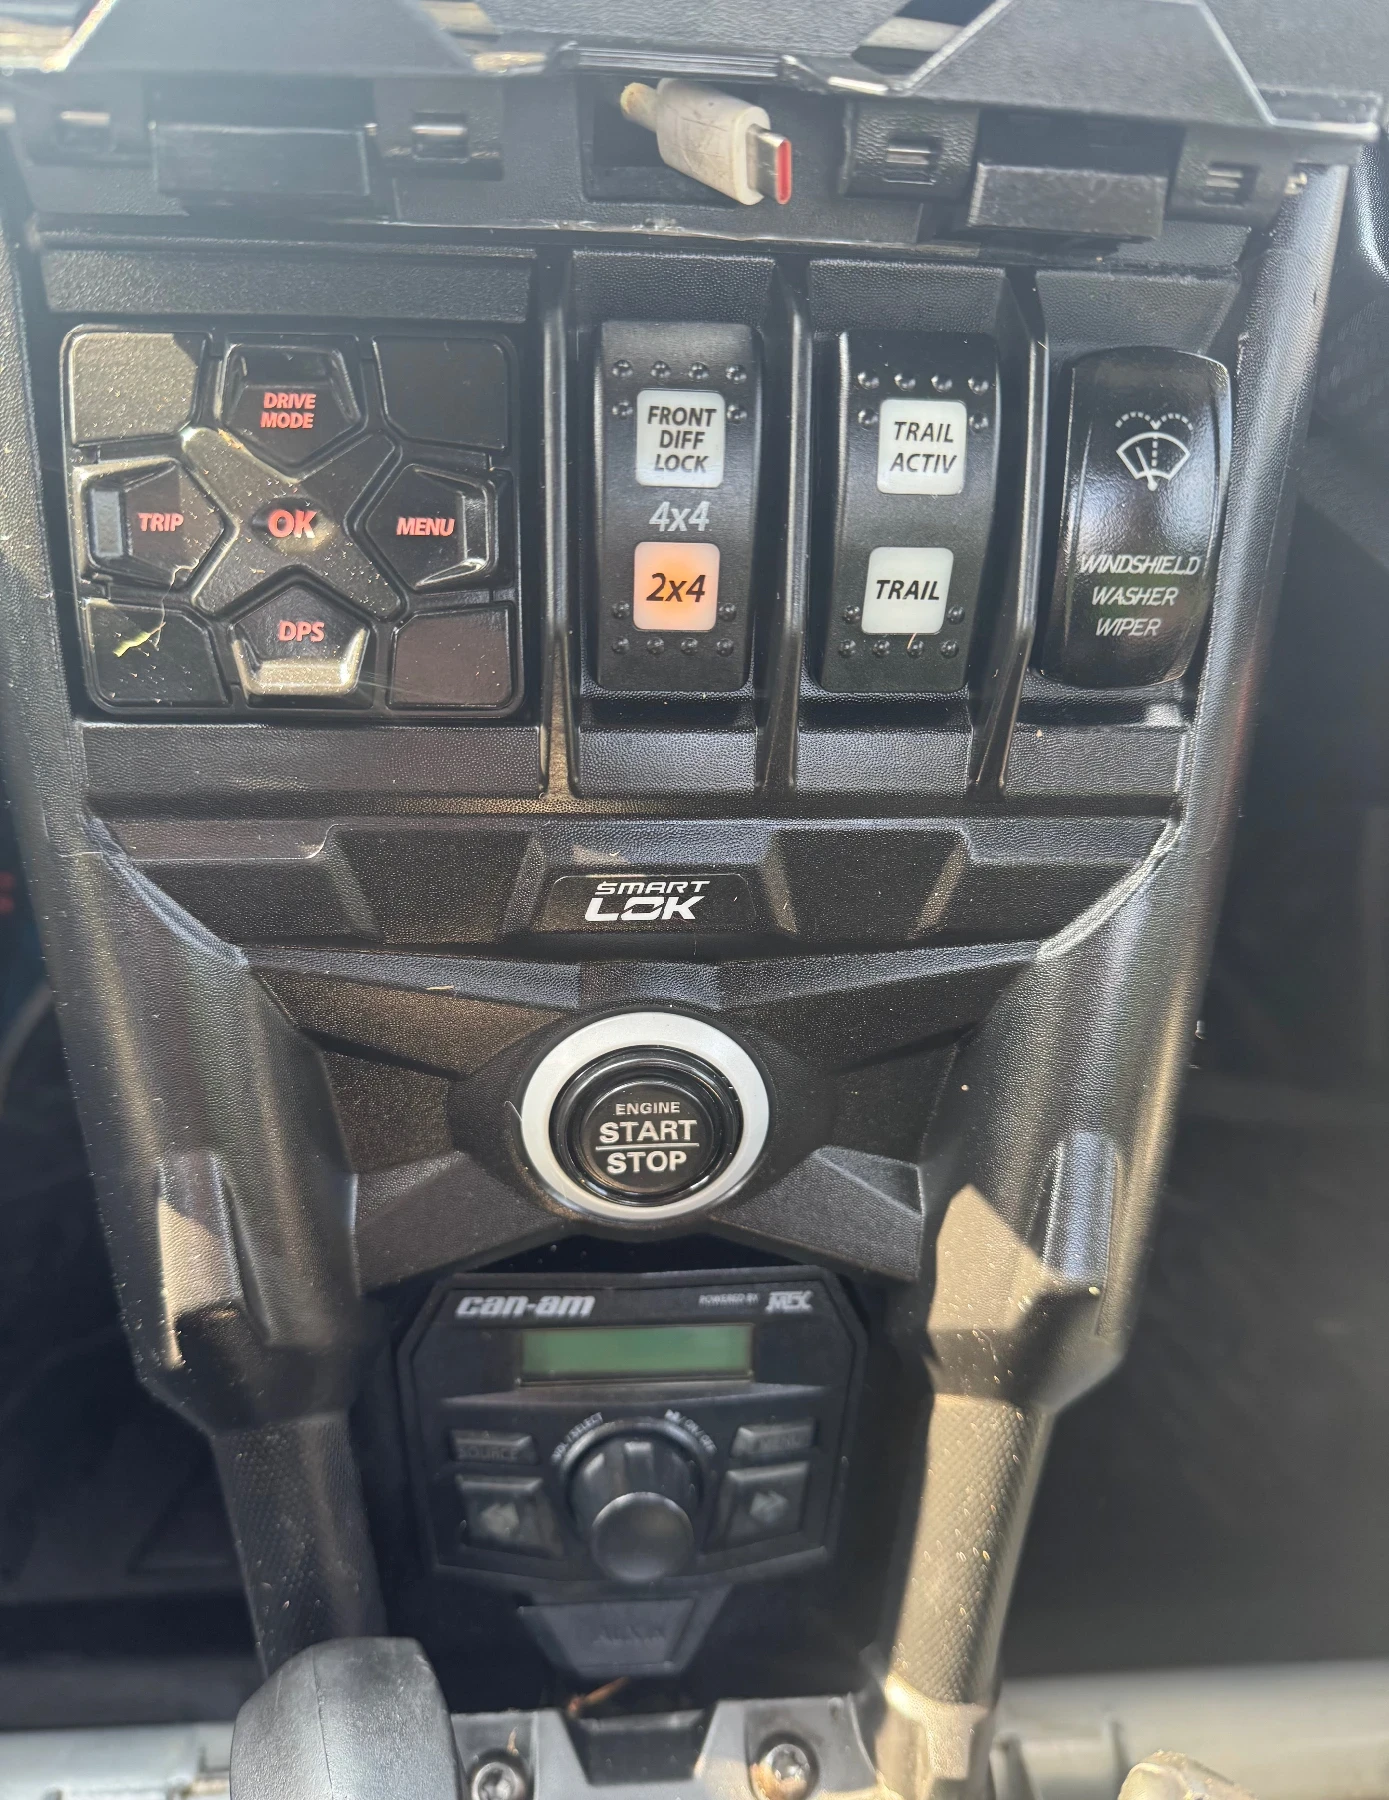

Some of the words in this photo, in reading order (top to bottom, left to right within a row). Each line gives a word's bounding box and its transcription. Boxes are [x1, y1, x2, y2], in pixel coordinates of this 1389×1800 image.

[262, 391, 317, 410] DRIVE
[260, 411, 314, 430] MODE
[647, 404, 717, 428] FRONT
[659, 430, 705, 450] DIFF
[893, 421, 954, 444] TRAIL
[654, 453, 709, 474] LOCK
[889, 452, 957, 475] ACTIV
[137, 512, 184, 532] TRIP
[267, 509, 317, 539] OK
[396, 517, 455, 537] MENU
[649, 501, 710, 532] 4x4
[1078, 554, 1201, 576] WINDSHIELD
[646, 572, 706, 603] 2x4
[875, 579, 941, 601] TRAIL
[1091, 586, 1179, 606] WASHER
[278, 621, 325, 643] DPS
[1095, 617, 1162, 637] WIPER
[594, 880, 710, 896] SMART
[584, 895, 706, 922] LOK
[614, 1101, 681, 1116] ENGINE
[599, 1119, 698, 1144] START
[606, 1150, 688, 1175] STOP
